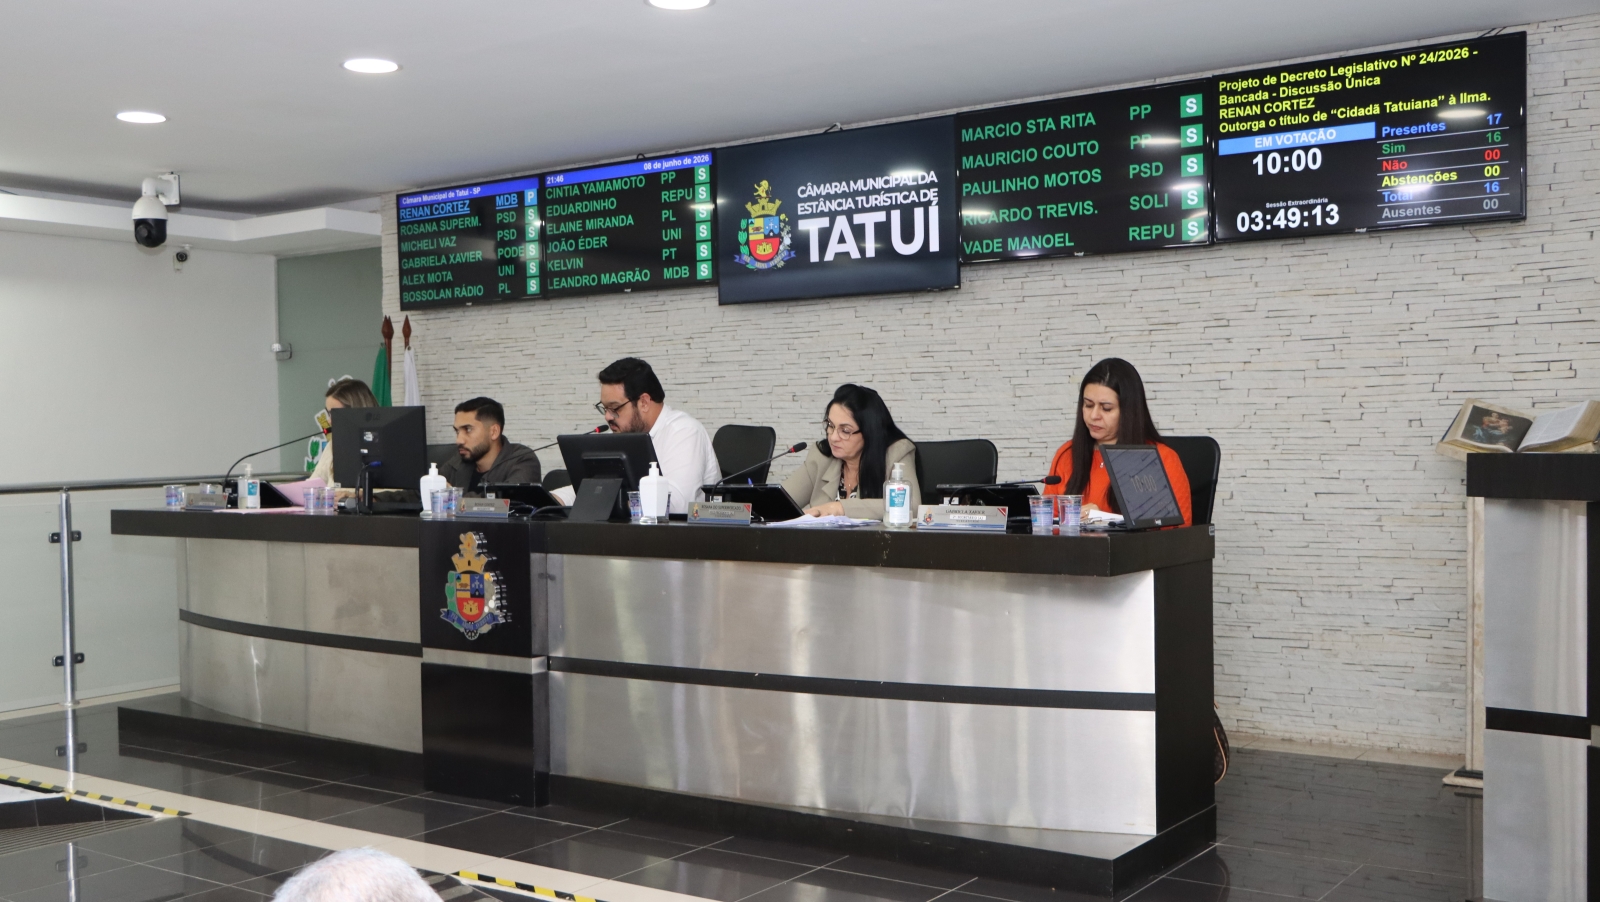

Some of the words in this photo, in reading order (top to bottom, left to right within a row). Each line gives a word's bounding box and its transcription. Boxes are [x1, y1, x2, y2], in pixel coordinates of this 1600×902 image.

[1220, 78, 1259, 91] Projeto
[1263, 75, 1277, 86] de
[1280, 69, 1327, 83] Decreto
[1330, 59, 1397, 77] Legislativo
[1402, 54, 1416, 66] Nº
[1419, 47, 1469, 64] 24/2026
[1220, 90, 1268, 105] Bancada
[1280, 81, 1342, 97] Discussão
[1346, 75, 1380, 88] Única
[962, 122, 1021, 142] MARCIO
[1027, 118, 1056, 134] STA
[1061, 112, 1096, 129] RITA
[1130, 105, 1151, 120] PP
[1186, 98, 1196, 113] S
[1220, 104, 1260, 119] RENAN
[1264, 97, 1315, 113] CORTEZ
[1220, 119, 1265, 133] Outorga
[1269, 119, 1276, 127] o
[1279, 113, 1309, 126] título
[1313, 111, 1327, 122] de
[1331, 104, 1380, 119] “Cidadã
[1384, 95, 1444, 113] Tatuiana”
[1448, 94, 1456, 105] à
[1460, 92, 1491, 104] Ilma.
[1255, 137, 1272, 148] EM
[1276, 128, 1336, 145] VOTAÇÃO
[1382, 121, 1446, 137] Presentes
[1487, 113, 1502, 125] 17
[963, 148, 1037, 169] MAURICIO
[1043, 141, 1099, 160] COUTO
[1131, 134, 1151, 149] PP
[1186, 128, 1197, 143] S
[1382, 143, 1405, 154] Sim
[1486, 132, 1501, 142] 16
[653, 161, 661, 169] de
[663, 159, 681, 169] junho
[684, 157, 691, 165] de
[693, 155, 709, 164] 2026
[1253, 148, 1322, 175] 10:00
[1382, 160, 1407, 171] Não
[1485, 149, 1500, 160] 00
[546, 184, 580, 199] CINTIA
[582, 176, 645, 194] YAMAMOTO
[661, 172, 675, 184] PP
[698, 168, 706, 180] S
[547, 175, 563, 184] 21:46
[798, 181, 849, 198] CÂMARA
[850, 174, 917, 192] MUNICIPAL
[918, 171, 937, 184] DA
[963, 176, 1039, 196] PAULINHO
[1044, 169, 1101, 188] MOTOS
[1130, 162, 1163, 179] PSD
[1187, 158, 1197, 172] S
[1382, 171, 1457, 187] Abstenções
[1485, 165, 1500, 176] 00
[400, 207, 430, 219] RENAN
[433, 201, 469, 215] CORTEZ
[496, 194, 518, 206] MDB
[528, 191, 534, 202] P
[423, 193, 447, 201] Municipal
[547, 198, 616, 217] EDUARDINHO
[662, 188, 692, 202] REPU
[699, 187, 706, 198] S
[798, 197, 854, 215] ESTÂNCIA
[856, 191, 918, 208] TURÍSTICA
[920, 188, 938, 202] DE
[1266, 200, 1286, 208] Sessão
[1288, 198, 1328, 206] Extraordinária
[1382, 189, 1412, 202] Total
[1484, 182, 1499, 193] 16
[547, 220, 582, 234] ELAINE
[586, 215, 634, 230] MIRANDA
[662, 210, 676, 222] PL
[699, 206, 707, 217] S
[964, 207, 1032, 226] RICARDO
[1037, 201, 1098, 219] TREVIS.
[1130, 194, 1168, 210] SOLI
[1188, 190, 1198, 205] S
[1237, 204, 1339, 232] 03:49:13
[1382, 205, 1441, 218] Ausentes
[1483, 199, 1498, 209] 00
[401, 222, 437, 235] ROSANA
[440, 216, 481, 230] SUPERM.
[497, 211, 516, 223] PSD
[528, 209, 534, 219] S
[798, 200, 939, 262] TATUÍ
[401, 240, 436, 252] MICHELI
[439, 236, 456, 247] VAZ
[497, 230, 516, 241] PSD
[529, 227, 535, 237] S
[547, 238, 575, 253] JOÃO
[579, 236, 607, 250] ÉDER
[663, 228, 682, 240] UNI
[700, 225, 707, 237] S
[963, 239, 1002, 254] VADE
[1008, 234, 1074, 251] MANOEL
[1129, 224, 1174, 241] REPU
[1188, 222, 1198, 236] S
[402, 256, 447, 269] GABRIELA
[449, 251, 482, 264] XAVIER
[498, 246, 524, 259] PODE
[529, 245, 535, 255] S
[548, 258, 583, 271] KELVIN
[663, 248, 677, 260] PT
[700, 245, 707, 256] S
[403, 275, 425, 285] ALEX
[428, 272, 452, 283] MOTA
[499, 265, 514, 276] UNI
[530, 263, 536, 273] S
[548, 274, 597, 289] LEANDRO
[601, 268, 650, 284] MAGRÃO
[664, 266, 689, 279] MDB
[700, 264, 708, 276] S
[403, 288, 451, 302] BOSSOLAN
[455, 284, 483, 297] RÁDIO
[499, 283, 510, 293] PL
[530, 280, 536, 291] S
[1131, 475, 1157, 492] 10:00
